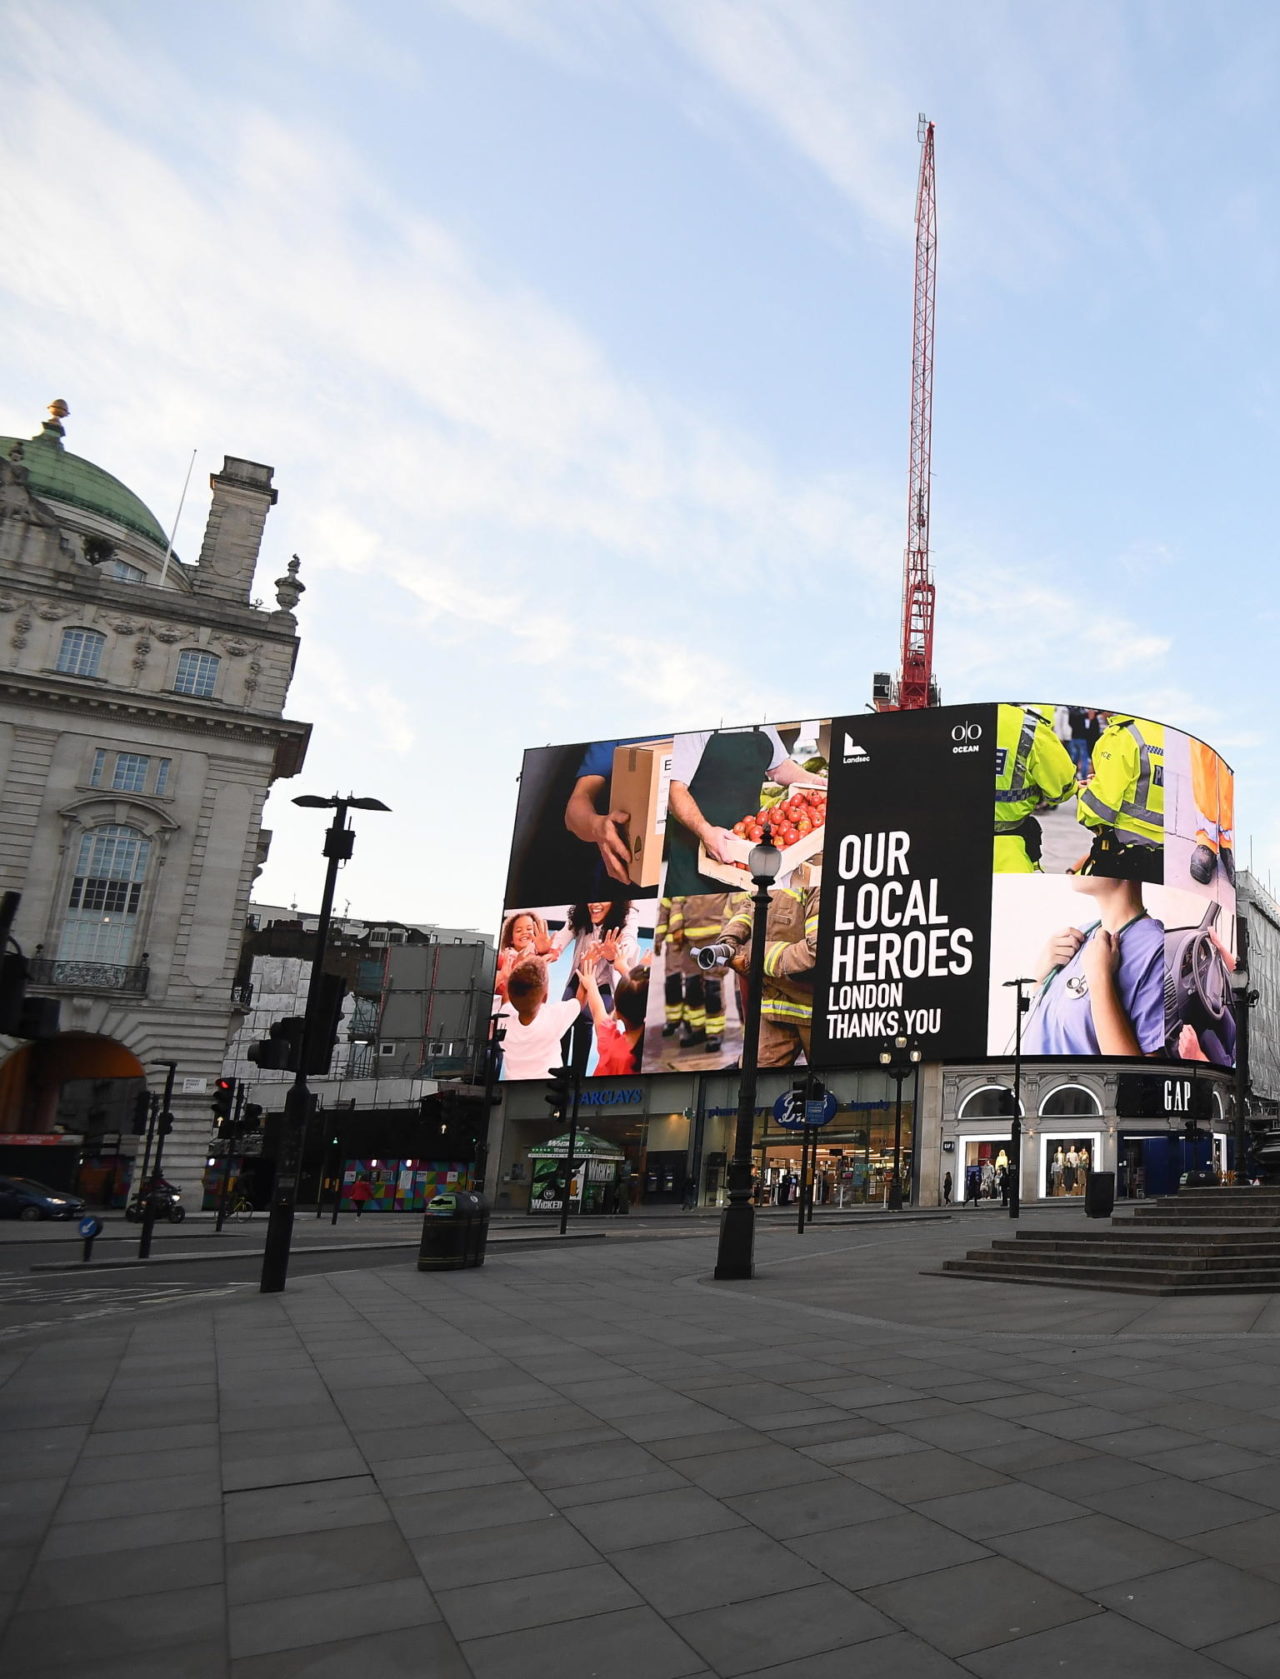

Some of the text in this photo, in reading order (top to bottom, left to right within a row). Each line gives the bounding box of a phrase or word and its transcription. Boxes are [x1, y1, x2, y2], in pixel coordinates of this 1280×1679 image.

[843, 755, 871, 764] Landsec
[952, 745, 979, 754] OCEAN
[838, 830, 911, 880] OUR
[834, 878, 949, 931] LOCAL
[831, 927, 974, 983] HEROES
[828, 982, 903, 1011] LONDON
[826, 1008, 942, 1040] THANKS YOU
[567, 1089, 642, 1105] ARCLAYS
[1164, 1080, 1191, 1111] GAP
